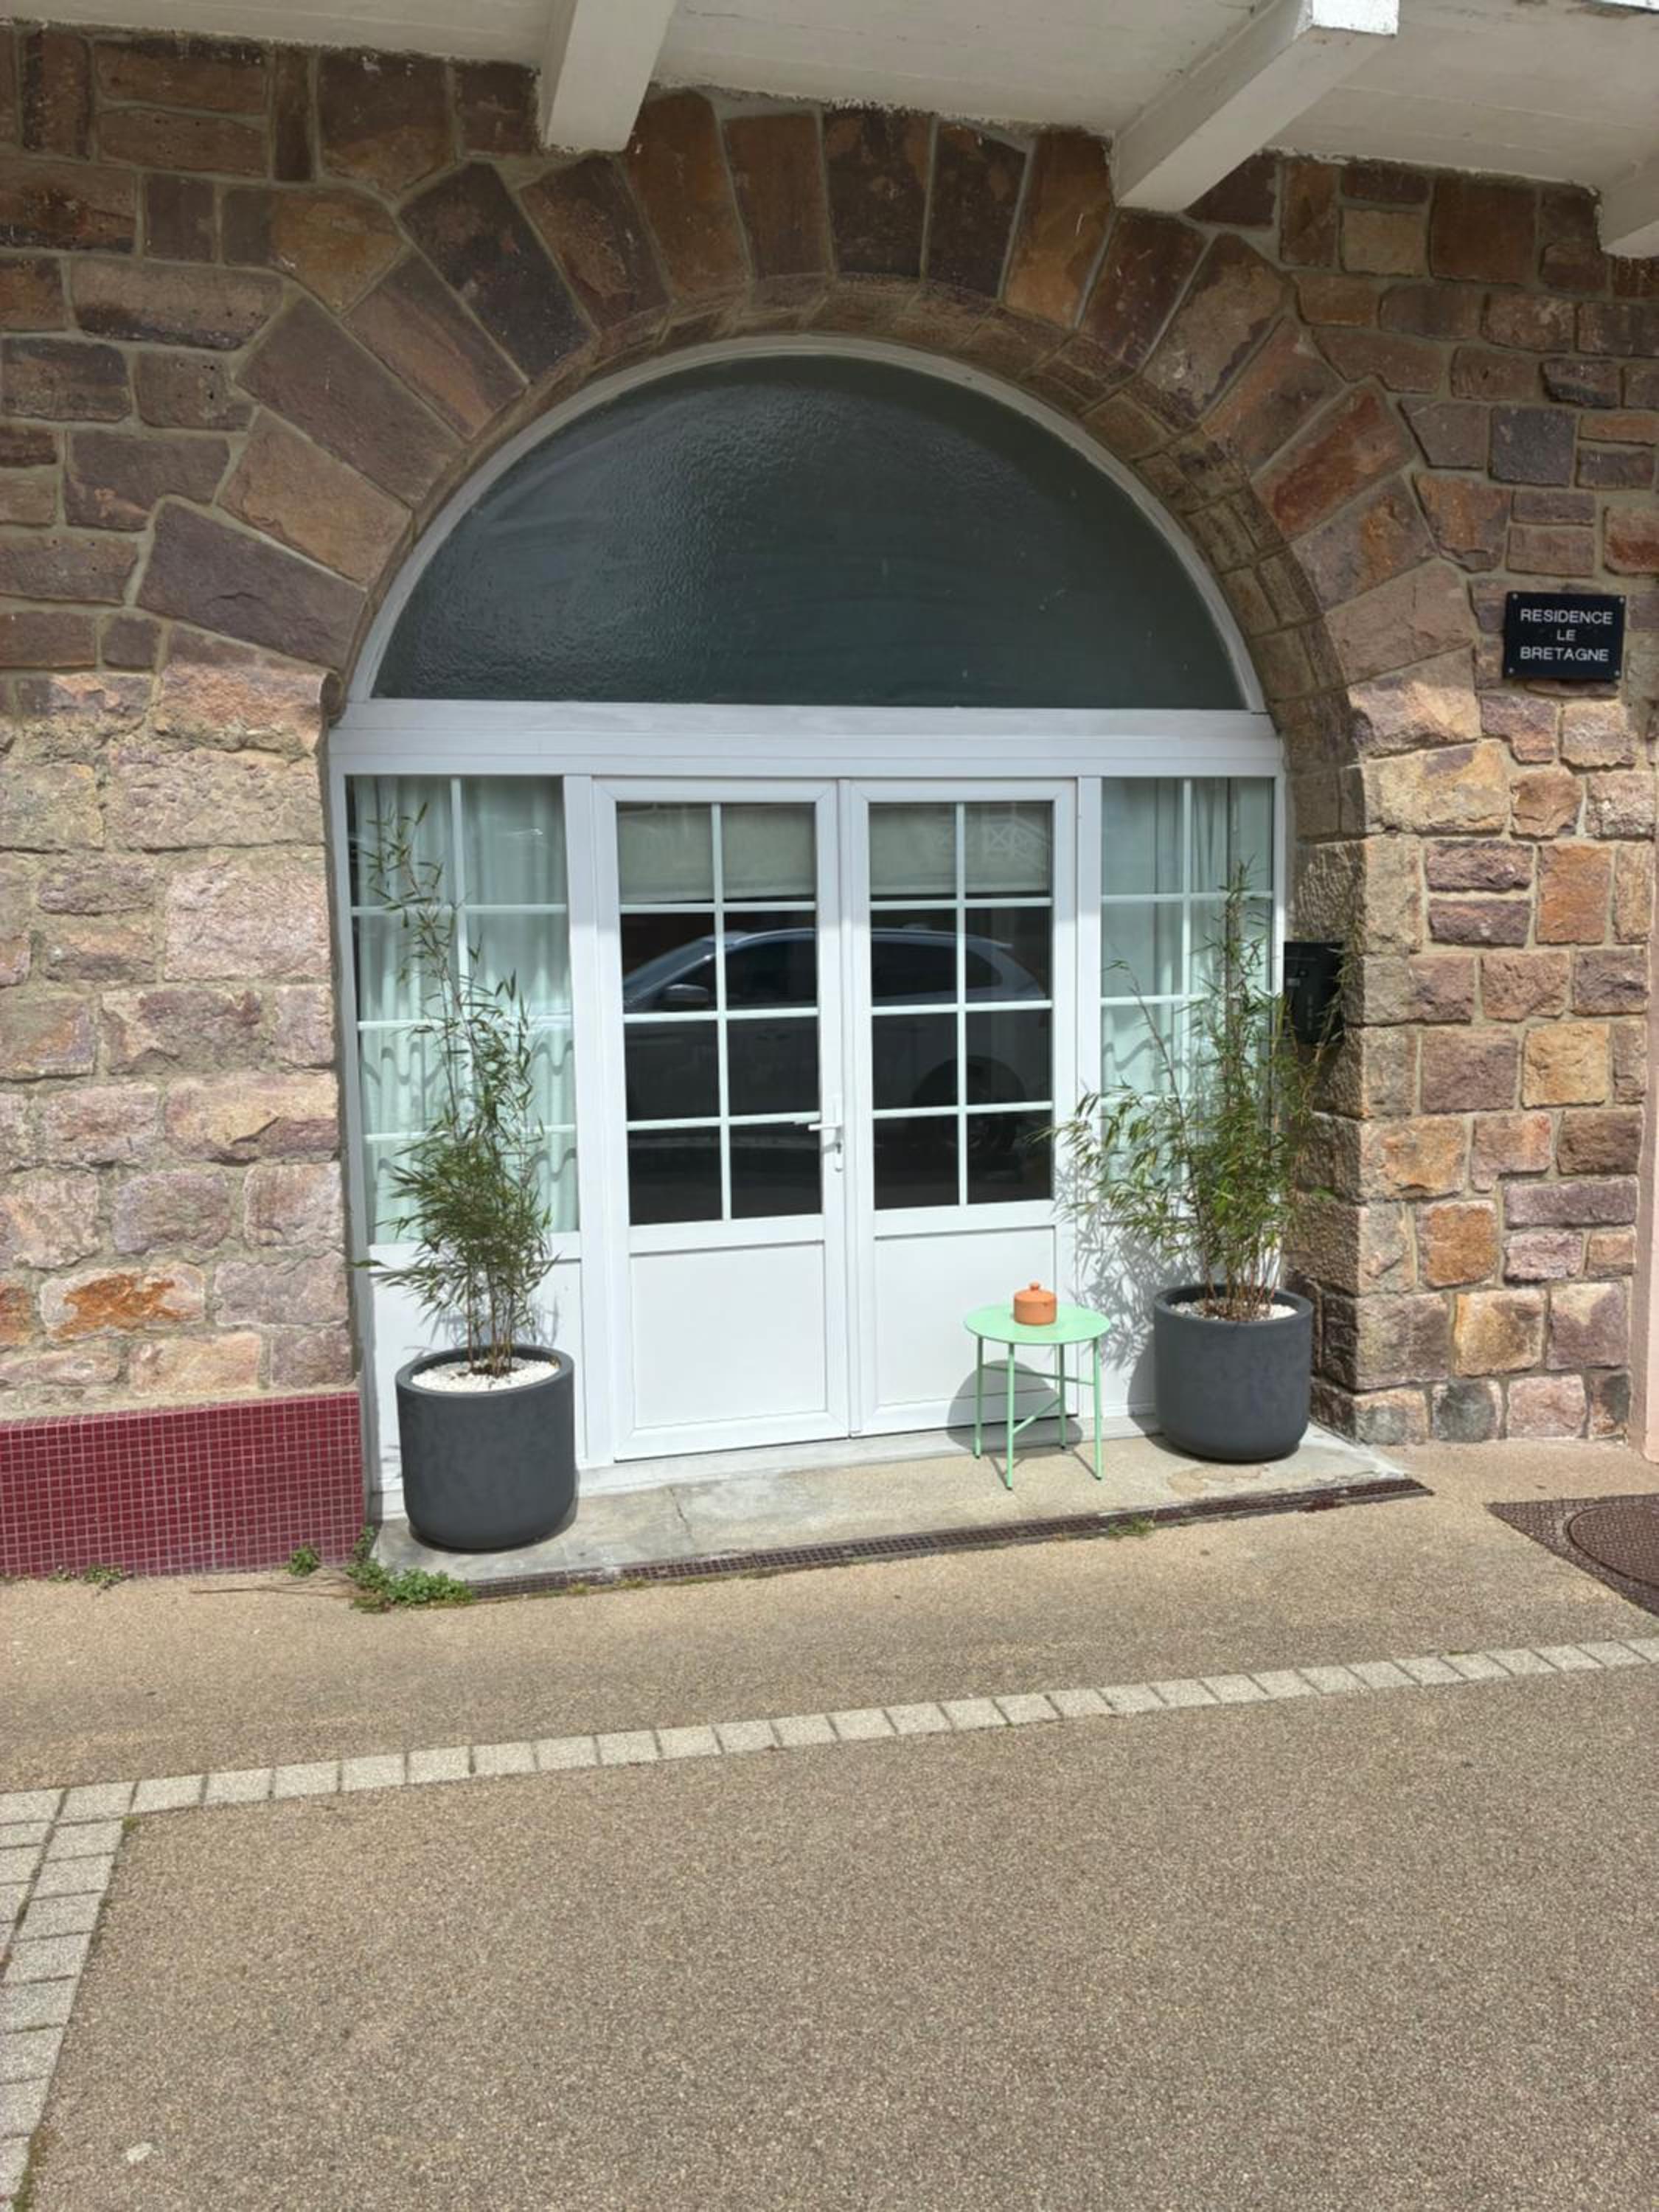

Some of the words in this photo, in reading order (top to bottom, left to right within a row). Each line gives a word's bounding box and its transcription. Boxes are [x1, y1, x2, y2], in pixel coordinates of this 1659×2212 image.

[1520, 608, 1613, 625] RESIDENCE
[1557, 629, 1576, 641] LE
[1520, 647, 1610, 662] BRETAGNE
